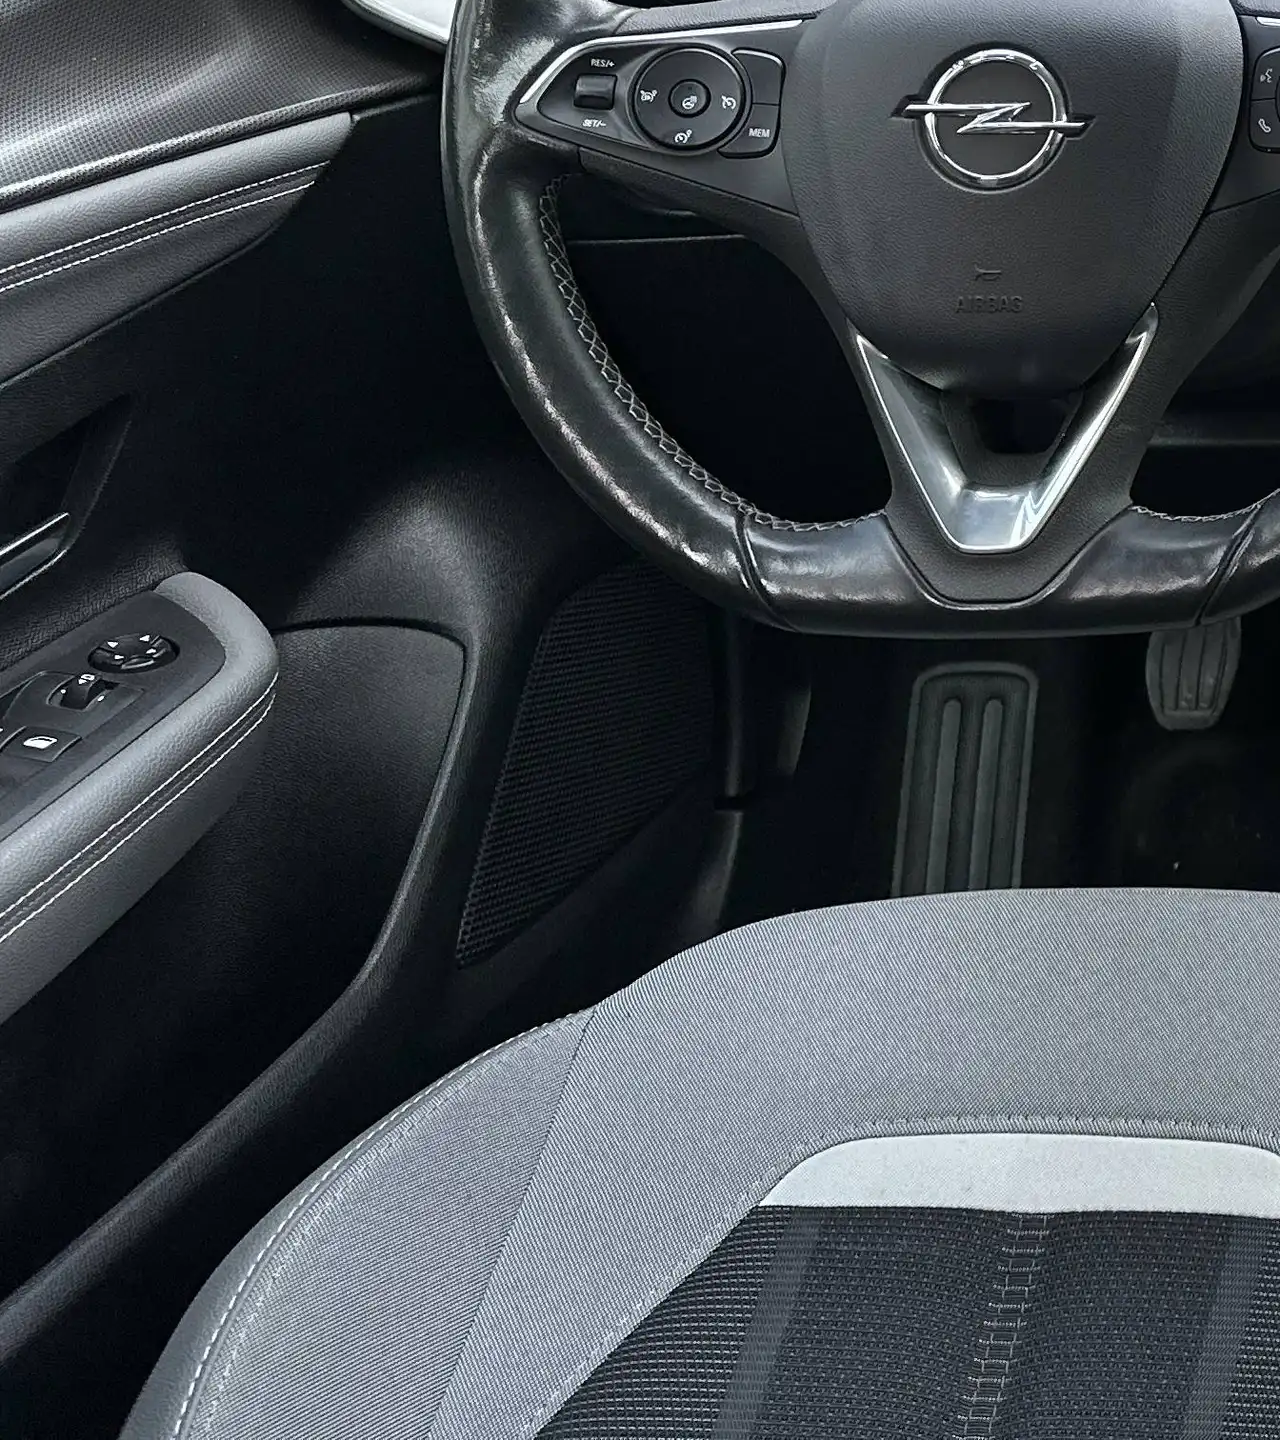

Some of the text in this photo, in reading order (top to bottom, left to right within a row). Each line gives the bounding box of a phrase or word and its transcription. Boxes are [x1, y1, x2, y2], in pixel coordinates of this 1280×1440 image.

[590, 59, 615, 68] RES/+
[749, 128, 770, 138] MEM
[956, 295, 1022, 314] AIRBAG
